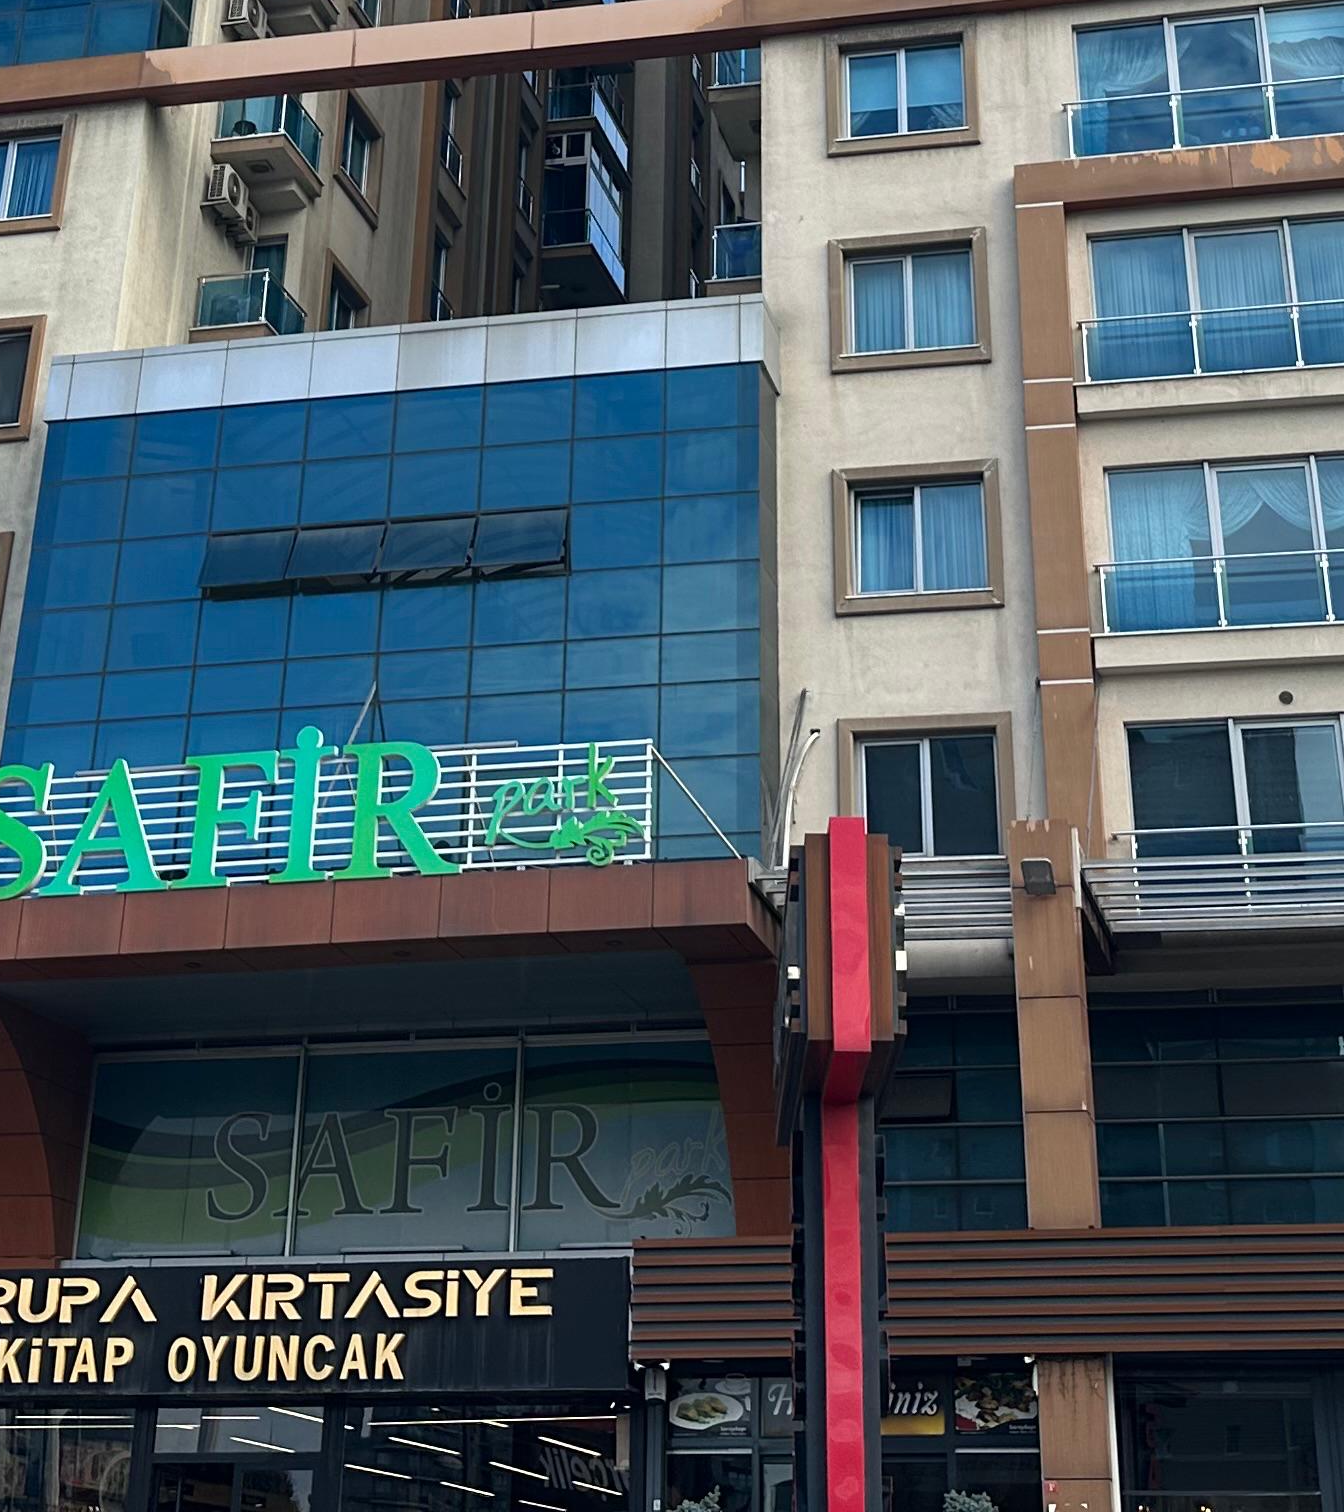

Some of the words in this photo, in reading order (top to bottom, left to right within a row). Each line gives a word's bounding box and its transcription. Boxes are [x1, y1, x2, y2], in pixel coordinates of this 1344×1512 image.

[485, 742, 619, 846] park
[206, 1082, 623, 1222] SAFİR
[199, 1267, 554, 1323] KIRTASİYE
[167, 1333, 405, 1383] OYUNCAK
